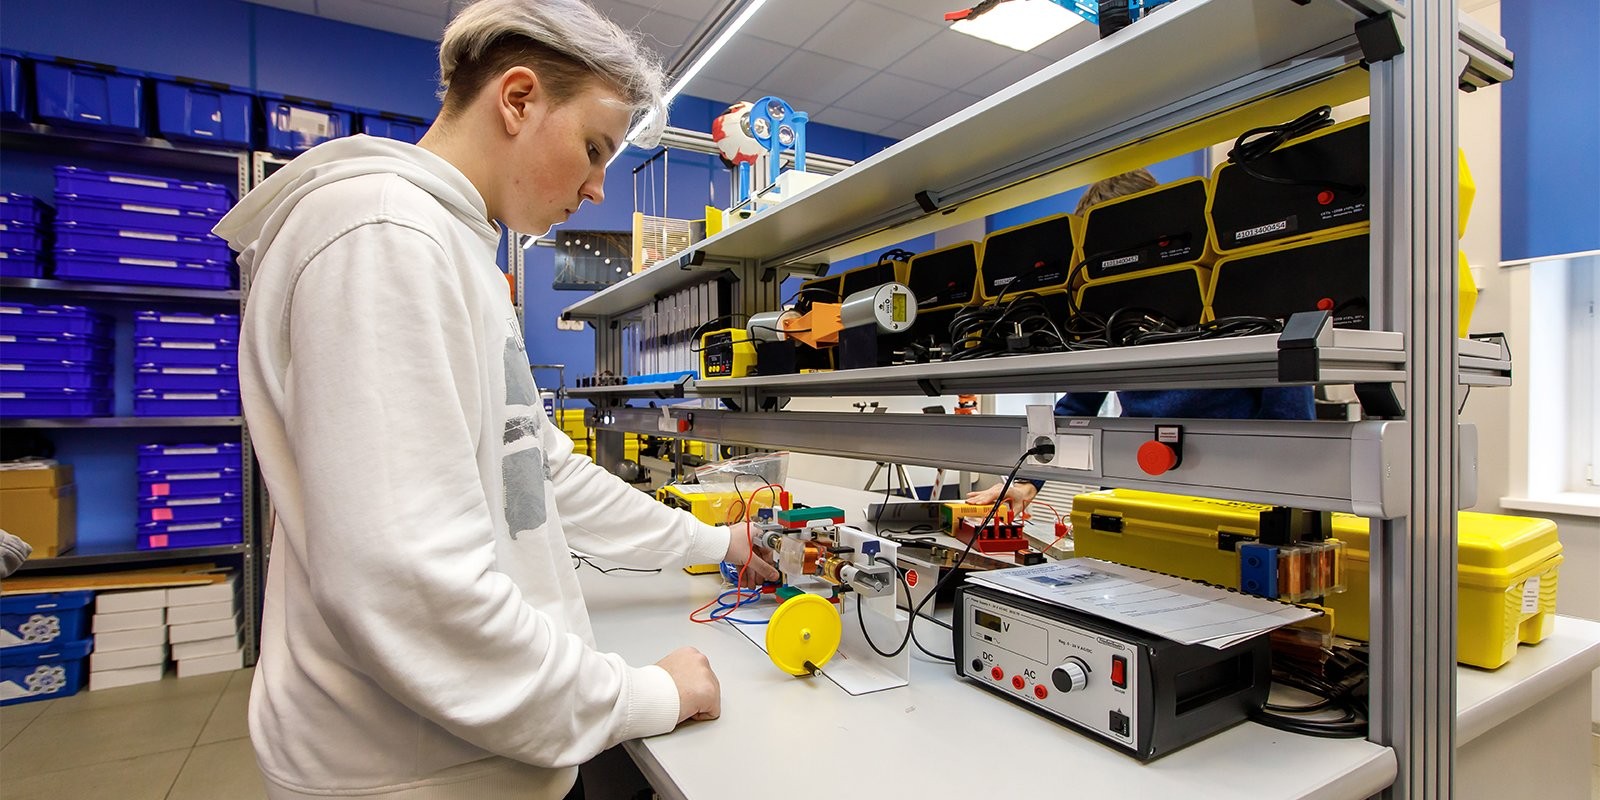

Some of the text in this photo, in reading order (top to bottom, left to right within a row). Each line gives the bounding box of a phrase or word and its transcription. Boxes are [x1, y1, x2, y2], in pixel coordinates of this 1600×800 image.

[1236, 222, 1285, 238] 41013400454
[1003, 622, 1011, 632] V
[982, 651, 994, 662] DC
[1023, 668, 1036, 680] AC
